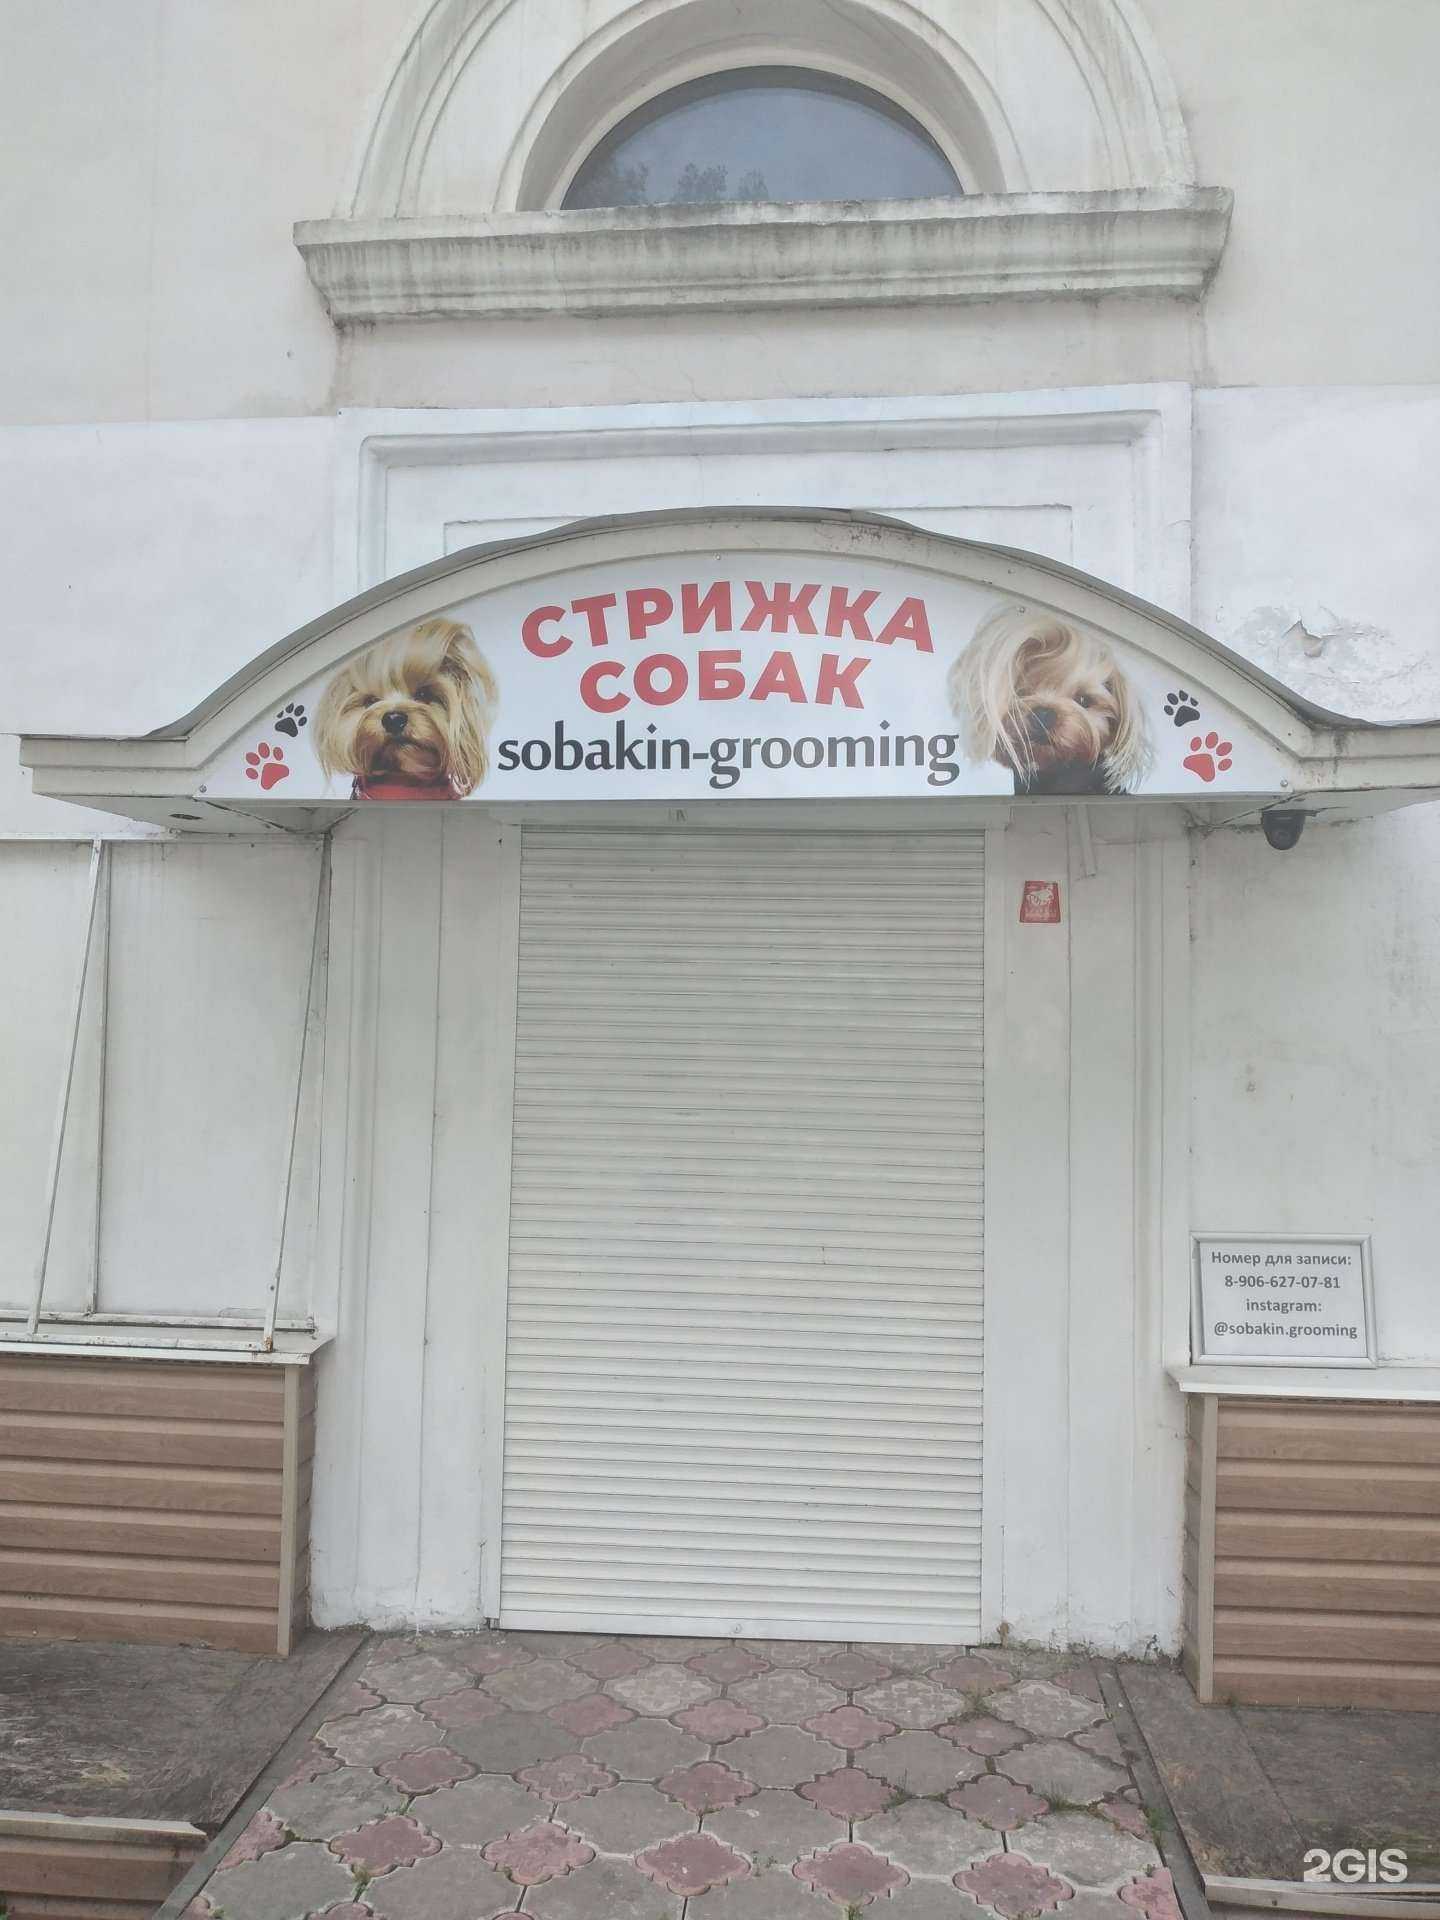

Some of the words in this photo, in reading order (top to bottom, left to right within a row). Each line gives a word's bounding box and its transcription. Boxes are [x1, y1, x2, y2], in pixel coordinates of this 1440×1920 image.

[521, 580, 935, 658] СТРИЖКА
[579, 649, 872, 714] СОБАК
[497, 720, 961, 789] sobakin-grooming
[1211, 1251, 1261, 1267] Номер
[1264, 1254, 1293, 1267] для
[1296, 1254, 1352, 1266] записи:
[1224, 1275, 1341, 1289] 8-906-627-07-81
[1246, 1298, 1322, 1314] instagram:
[1214, 1321, 1358, 1339] @sobakin.grooming
